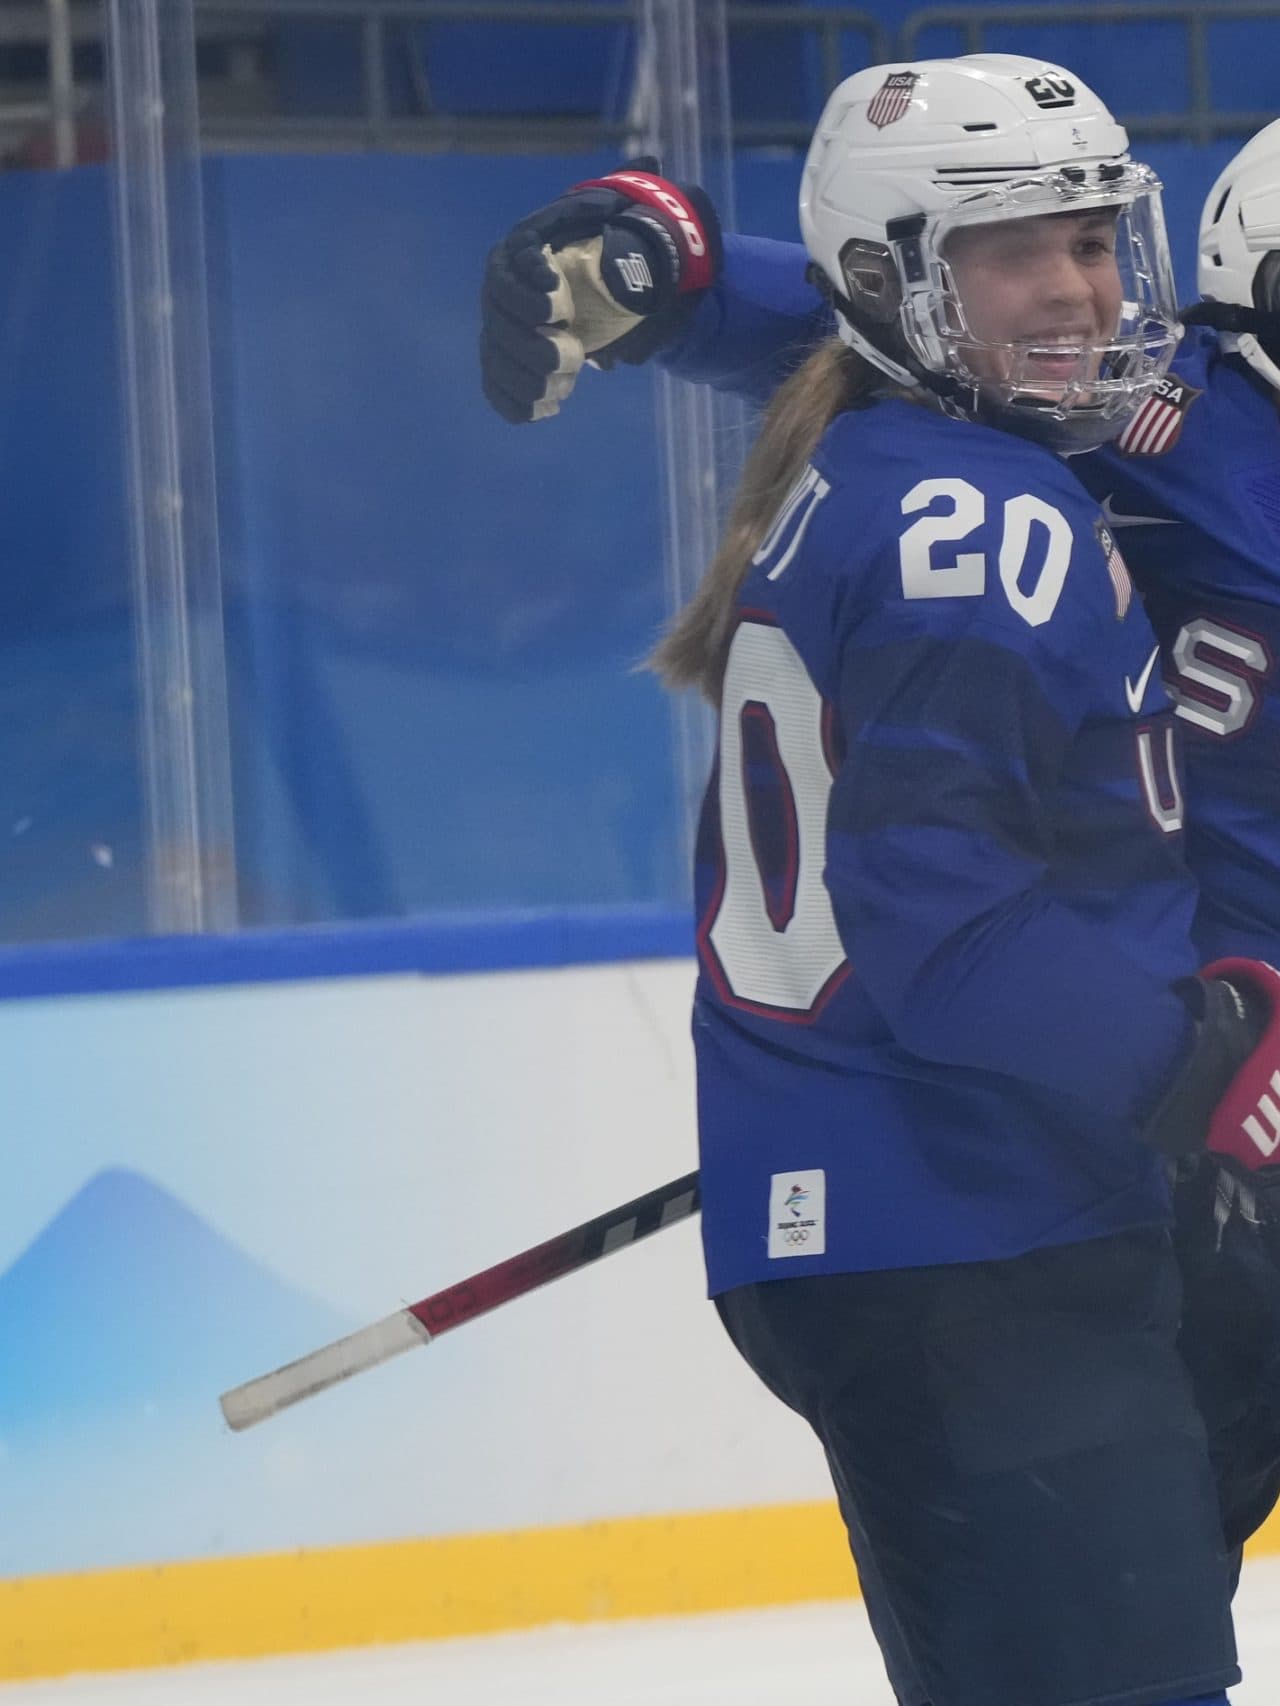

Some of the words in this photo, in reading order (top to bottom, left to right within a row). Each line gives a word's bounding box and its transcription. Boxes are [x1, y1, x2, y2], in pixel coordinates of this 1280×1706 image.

[600, 175, 705, 257] OOD
[1155, 378, 1184, 404] SA
[899, 477, 1074, 627] 20
